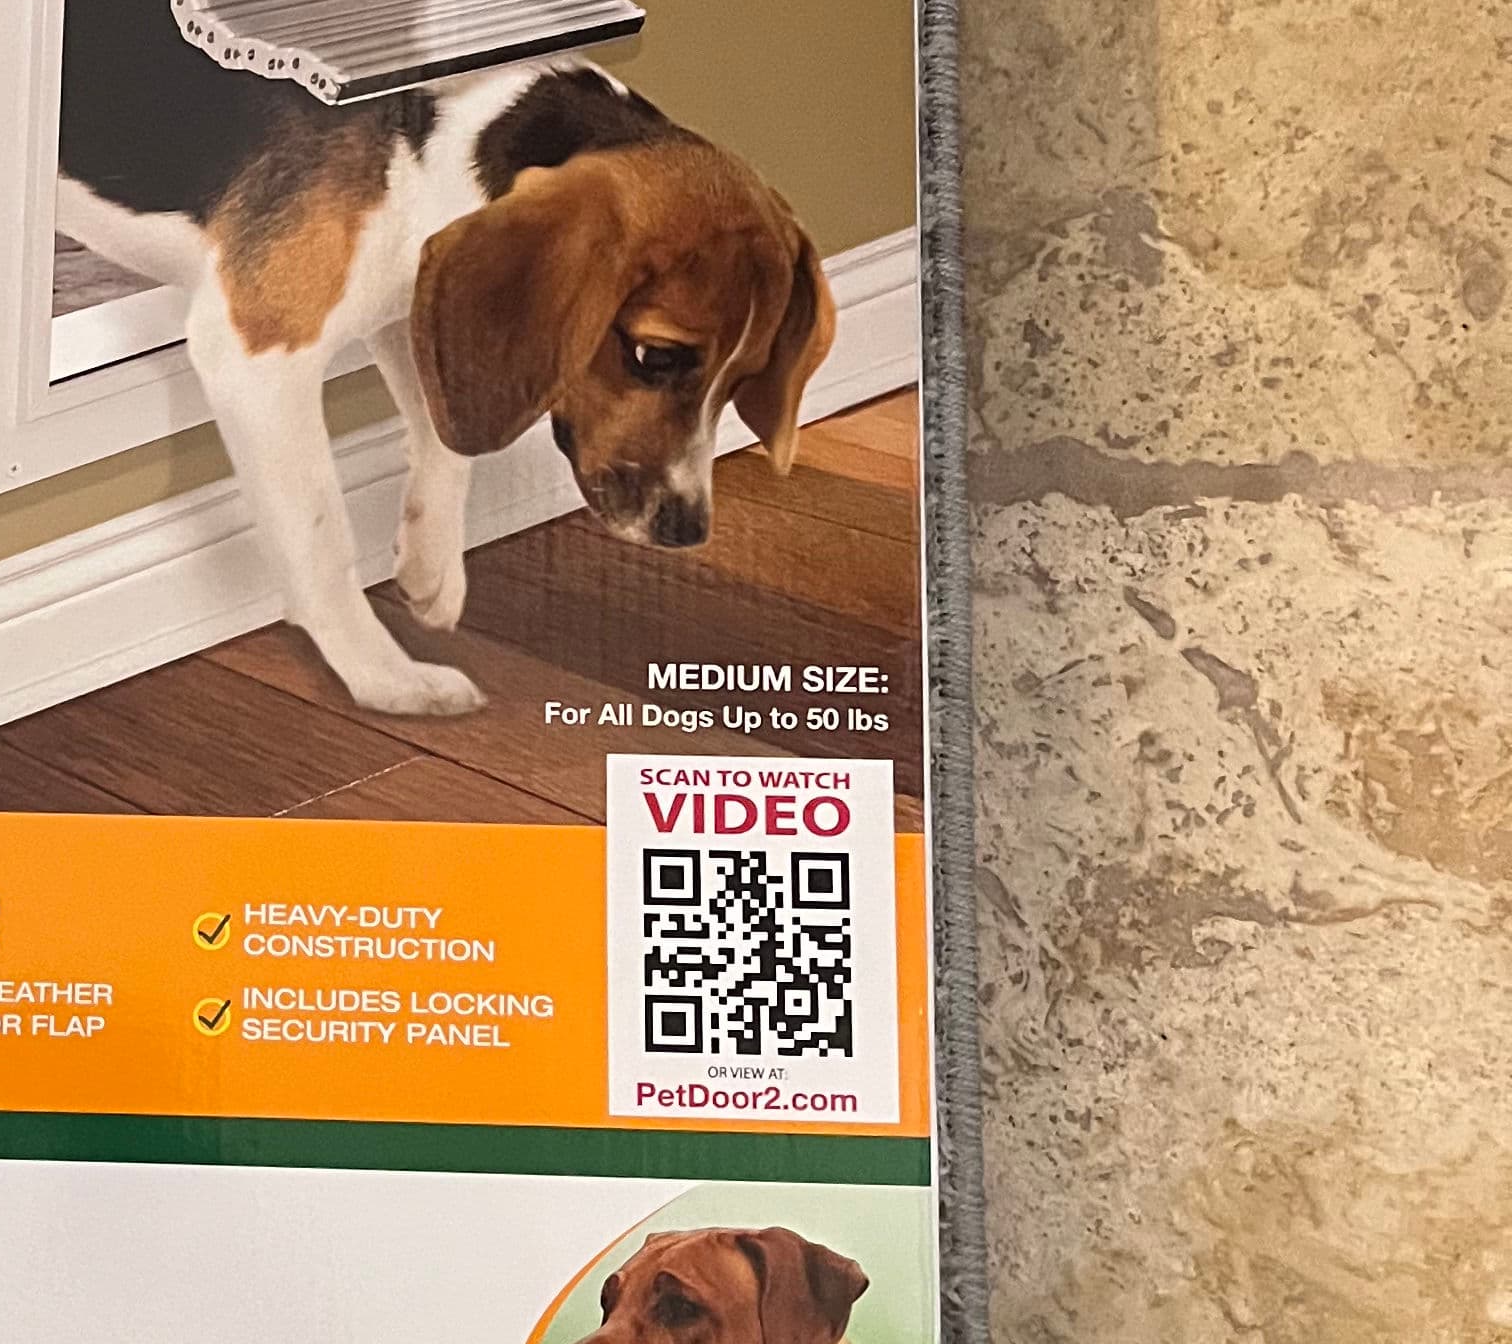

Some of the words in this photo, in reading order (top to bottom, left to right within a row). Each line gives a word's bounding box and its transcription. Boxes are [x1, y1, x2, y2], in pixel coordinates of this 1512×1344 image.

[648, 664, 792, 692] MEDIUM
[802, 666, 889, 695] SIZE:
[544, 703, 590, 725] For
[598, 703, 634, 727] All
[640, 705, 716, 732] Dogs
[722, 707, 762, 734] Up
[767, 709, 798, 730] to
[806, 708, 842, 731] 50
[848, 708, 889, 732] lbs
[640, 768, 713, 787] SCAN
[719, 770, 754, 788] TO
[759, 770, 851, 790] WATCH
[644, 792, 852, 837] VIDEO
[244, 904, 443, 930] HEAVY-DUTY
[243, 935, 496, 961] CONSTRUCTION
[242, 988, 402, 1014] INCLUDES
[410, 991, 555, 1018] LOCKING
[32, 1014, 106, 1037] FLAP
[242, 1018, 399, 1045] SECURITY
[407, 1022, 510, 1047] PANEL
[707, 1065, 727, 1079] OR
[729, 1066, 760, 1080] VIEW
[763, 1066, 788, 1080] AT:
[637, 1082, 858, 1114] PetDoor2.com
